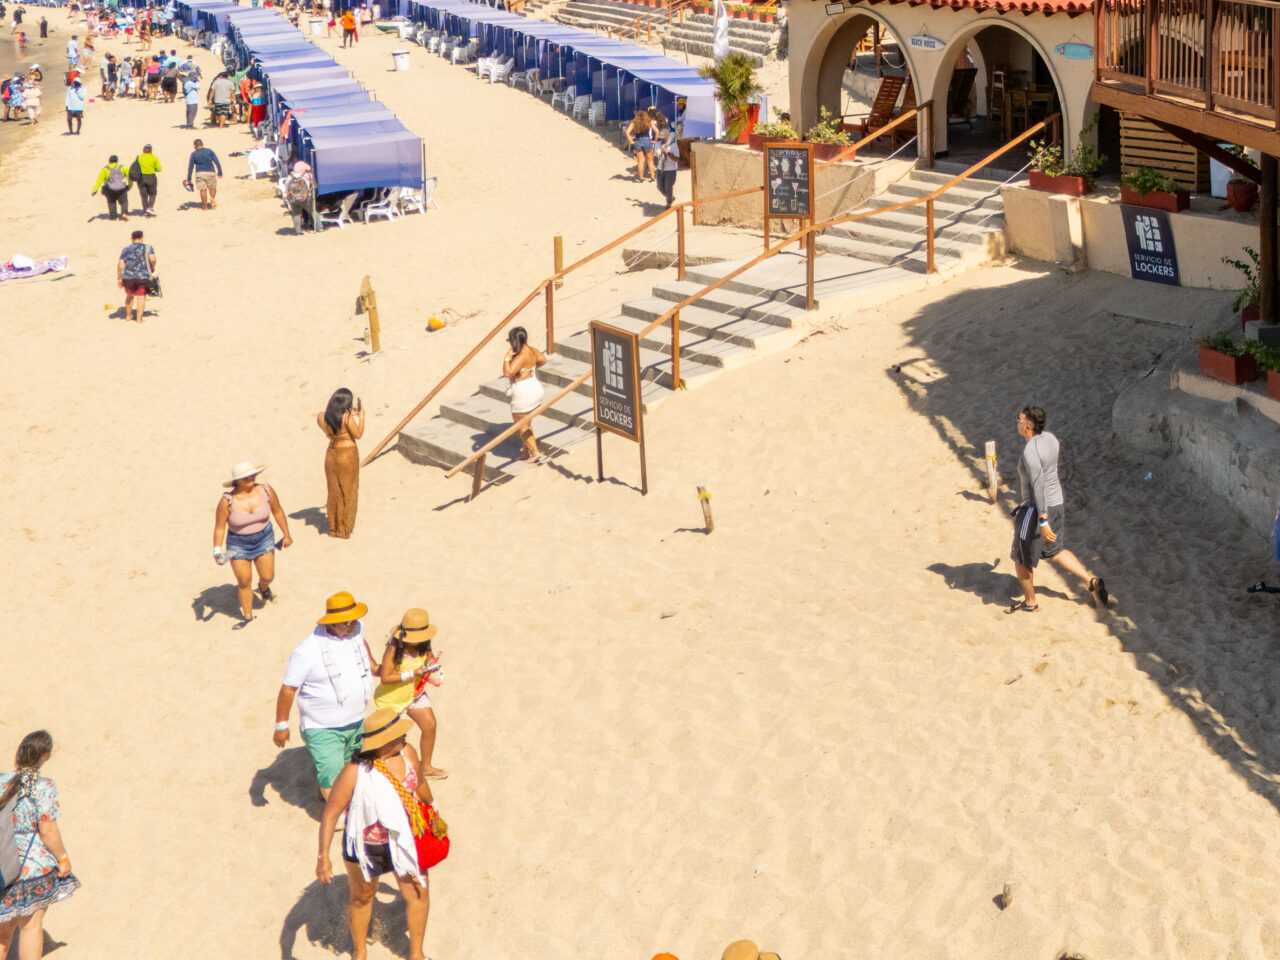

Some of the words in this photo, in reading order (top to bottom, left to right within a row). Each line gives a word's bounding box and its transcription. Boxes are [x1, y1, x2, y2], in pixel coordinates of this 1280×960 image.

[1134, 253, 1162, 265] SERVICIO
[1163, 257, 1173, 266] DE
[1135, 261, 1175, 277] LOCKERS
[600, 396, 623, 411] SERVICIO
[623, 405, 632, 415] DE
[599, 404, 633, 429] LOCKERS
